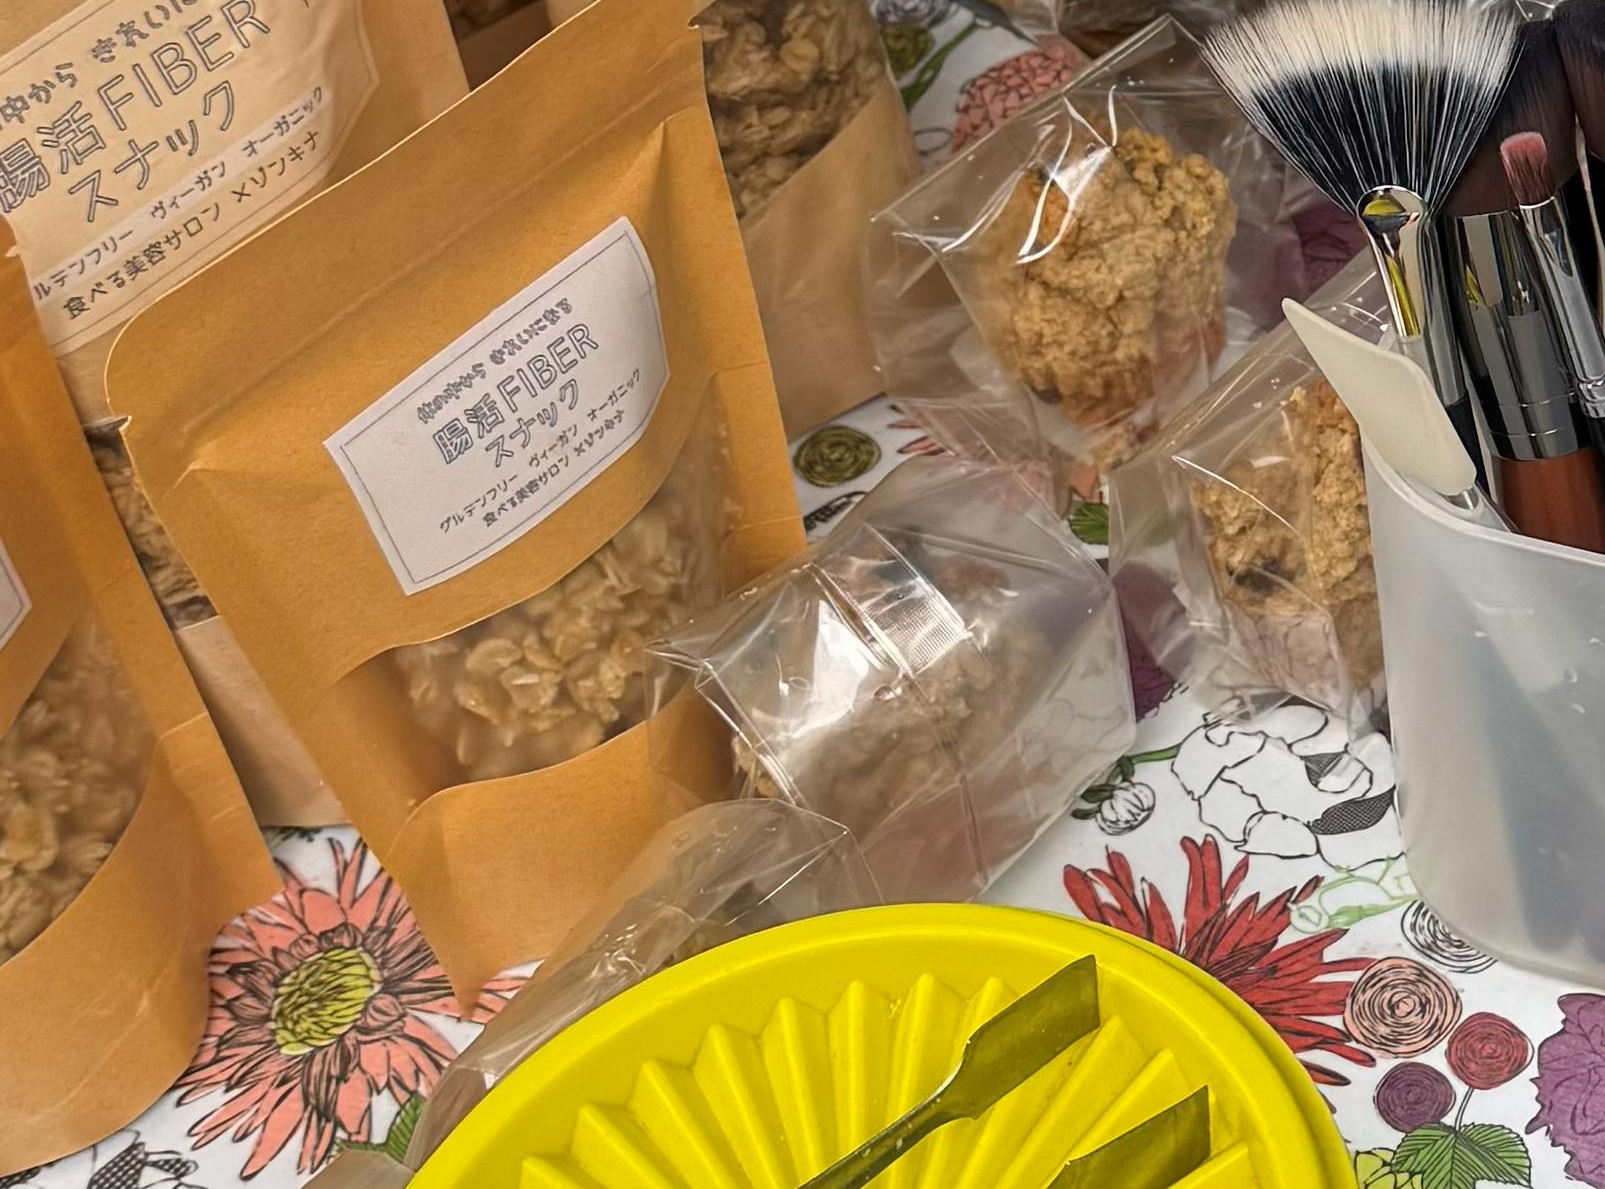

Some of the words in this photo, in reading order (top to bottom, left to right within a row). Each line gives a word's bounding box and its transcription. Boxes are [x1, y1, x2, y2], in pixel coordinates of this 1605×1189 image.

[0, 61, 77, 131] 中から
[33, 229, 134, 301] ルテンフリー
[150, 161, 227, 220] ヴィーガン
[242, 85, 325, 159] オーガニック
[67, 79, 235, 223] スナック
[63, 202, 222, 319] 食べる美容サロン
[489, 297, 574, 366] きれいになる
[484, 378, 580, 469] スナック
[439, 473, 519, 534] グルテンフリー
